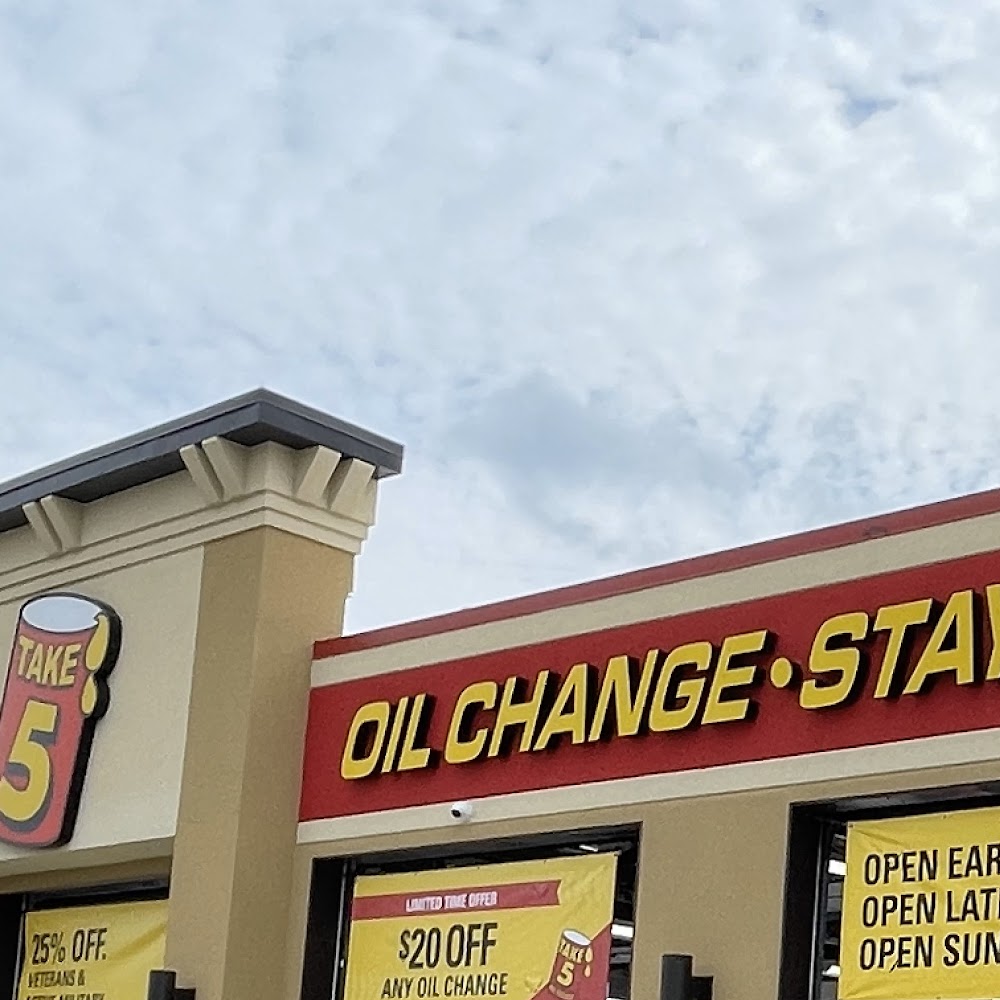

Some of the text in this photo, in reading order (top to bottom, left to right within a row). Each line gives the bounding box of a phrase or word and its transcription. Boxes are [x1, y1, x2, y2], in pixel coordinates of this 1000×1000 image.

[17, 635, 82, 686] TAKE
[340, 701, 432, 780] OIL
[445, 630, 769, 765] CHANGE
[0, 699, 58, 822] 5
[864, 849, 938, 885] OPEN
[405, 891, 497, 912] LIMITED TIME OFFER
[862, 891, 936, 928] OPEN
[32, 927, 107, 965] 25% OFF.
[399, 922, 498, 969] $20 OFF
[859, 935, 934, 971] OPEN
[28, 969, 75, 988] VETERANS
[381, 973, 508, 999] ANY OIL CHANGE
[556, 961, 574, 986] 5
